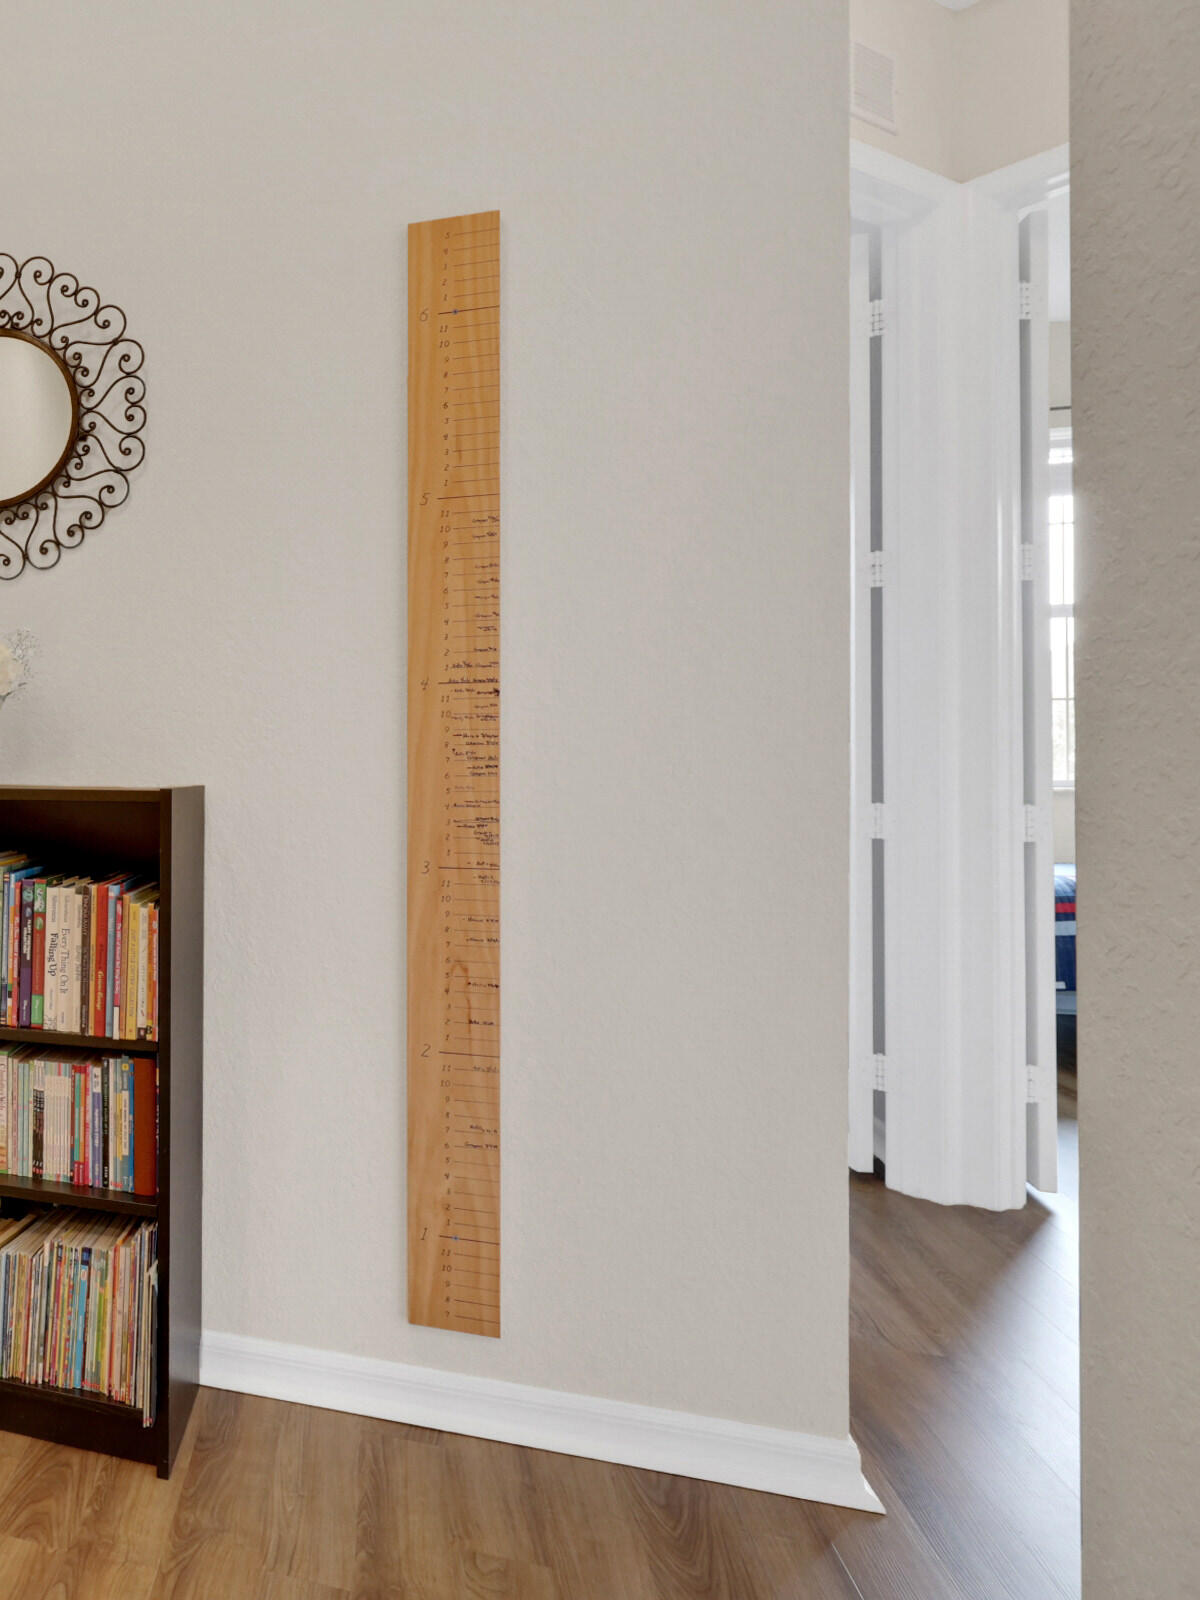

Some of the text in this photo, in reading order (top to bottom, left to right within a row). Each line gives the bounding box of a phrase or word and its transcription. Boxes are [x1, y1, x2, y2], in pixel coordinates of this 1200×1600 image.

[419, 308, 429, 322] 6
[419, 492, 432, 506] 5
[420, 674, 429, 690] 4
[422, 861, 431, 874] 3
[440, 895, 451, 903] 10
[60, 928, 70, 950] Every
[48, 933, 59, 963] Falling
[60, 951, 70, 974] Thing
[48, 964, 57, 977] Up
[60, 974, 69, 987] On
[420, 1043, 431, 1058] 2
[420, 1227, 427, 1241] 1
